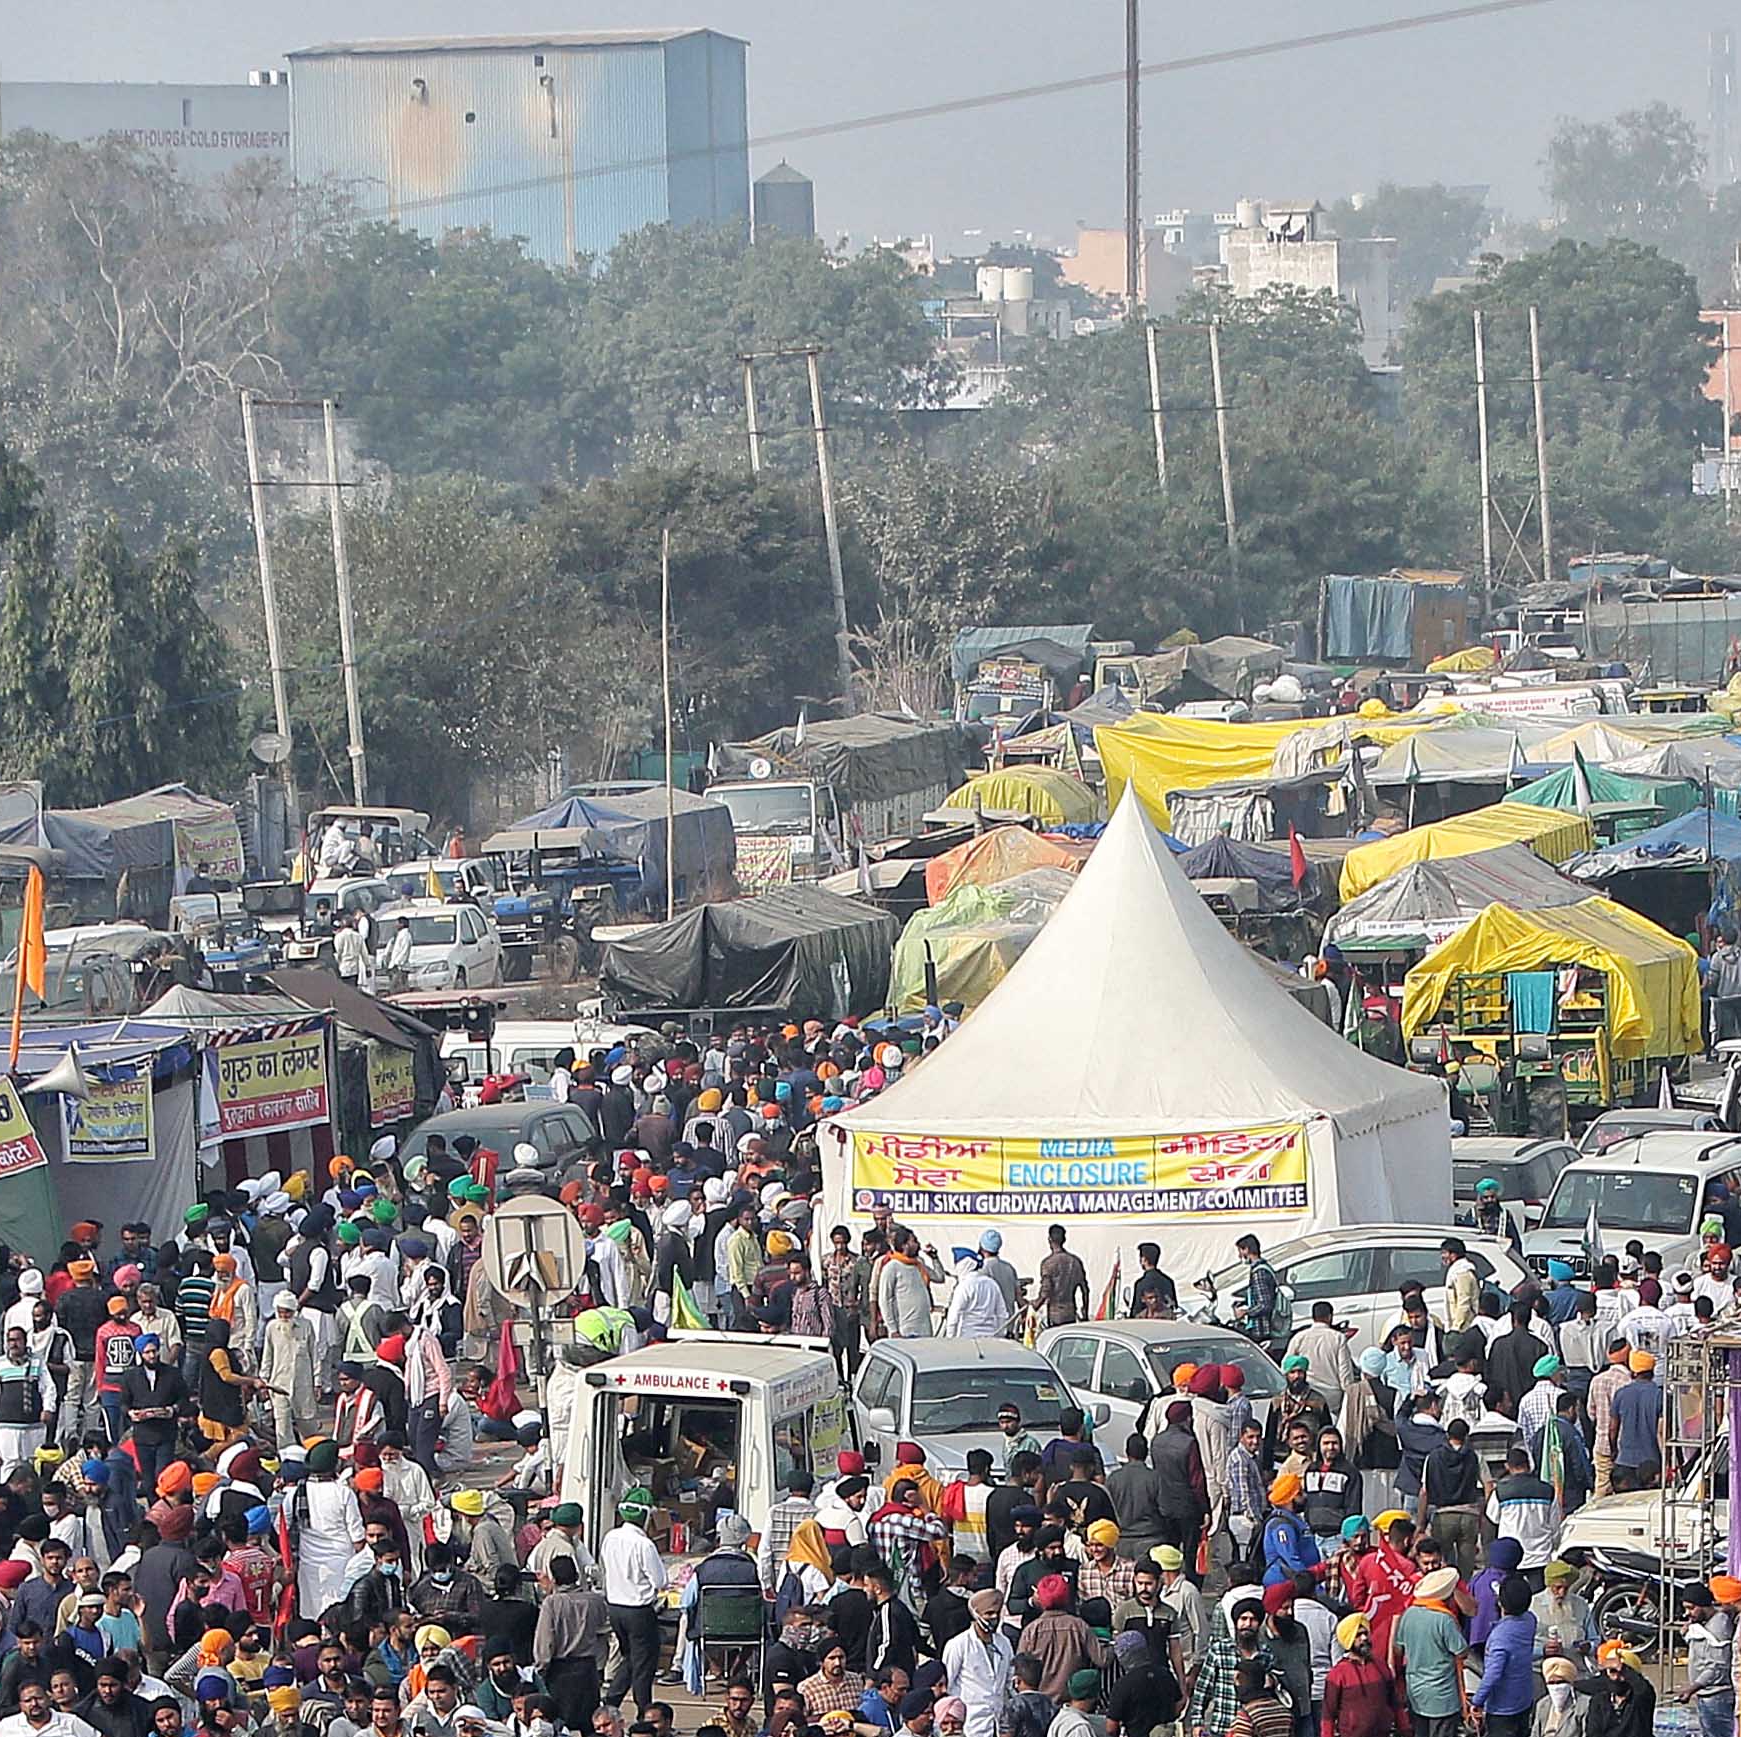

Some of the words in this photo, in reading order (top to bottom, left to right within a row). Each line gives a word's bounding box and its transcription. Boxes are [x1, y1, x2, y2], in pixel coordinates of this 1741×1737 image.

[189, 130, 219, 148] COLD
[221, 131, 269, 148] STORAGE
[258, 1053, 278, 1079] का
[282, 1041, 320, 1079] लंगर
[1039, 1138, 1115, 1159] MEDIA
[1008, 1161, 1148, 1188] ENCLOSURE
[882, 1192, 931, 1212] DELHI
[933, 1192, 970, 1212] SIKH
[976, 1192, 1074, 1213] GURDWARA
[1083, 1191, 1199, 1212] MANAGEMENT
[1204, 1187, 1306, 1208] COMMITTEE
[633, 1374, 710, 1390] AMBULANCE
